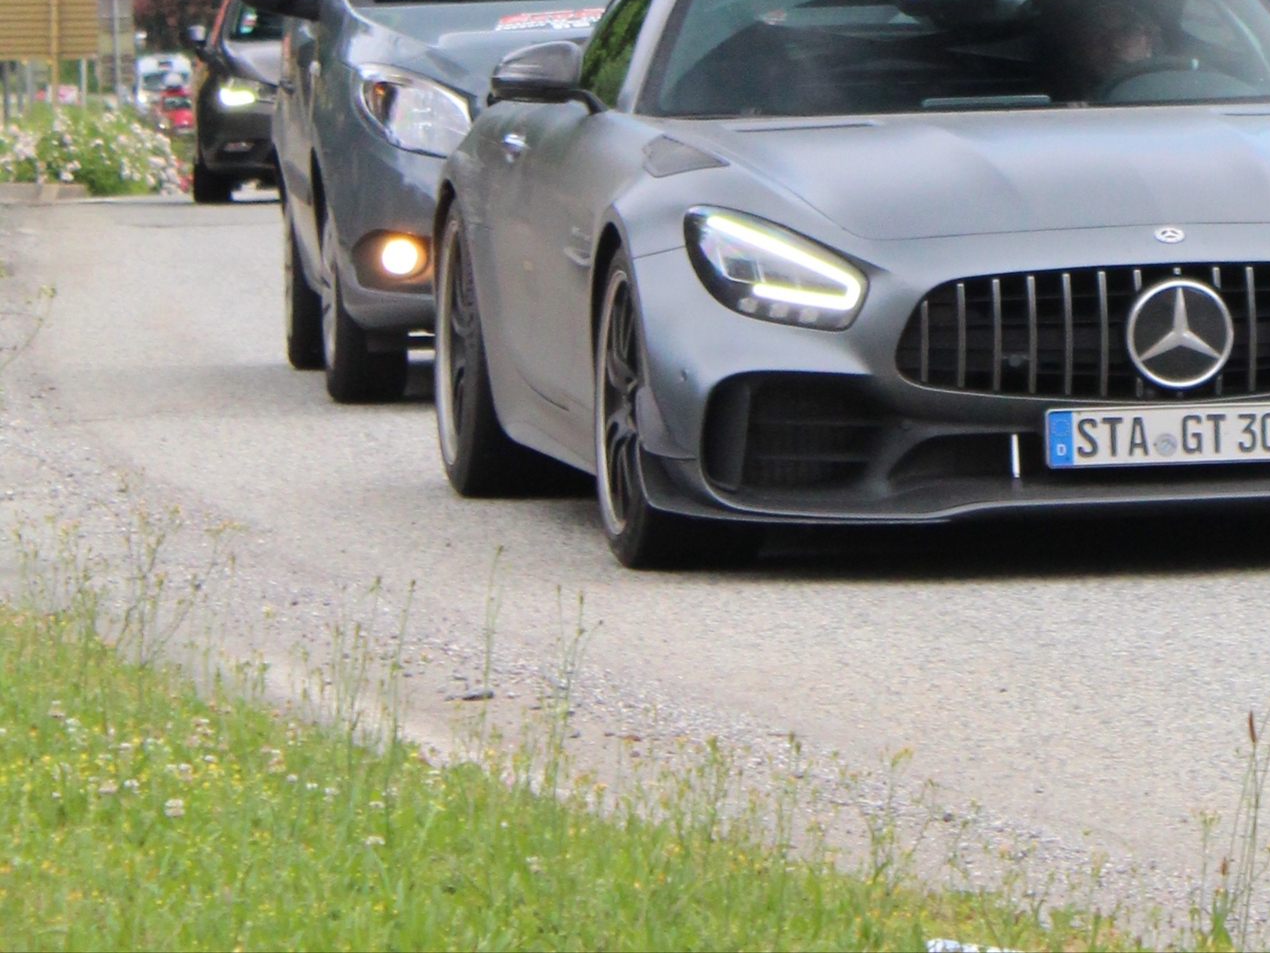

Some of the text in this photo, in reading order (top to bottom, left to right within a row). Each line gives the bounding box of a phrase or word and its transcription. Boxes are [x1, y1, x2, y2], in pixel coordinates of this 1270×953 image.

[1057, 444, 1066, 456] D
[1076, 416, 1150, 459] STA
[1181, 413, 1227, 454] GT
